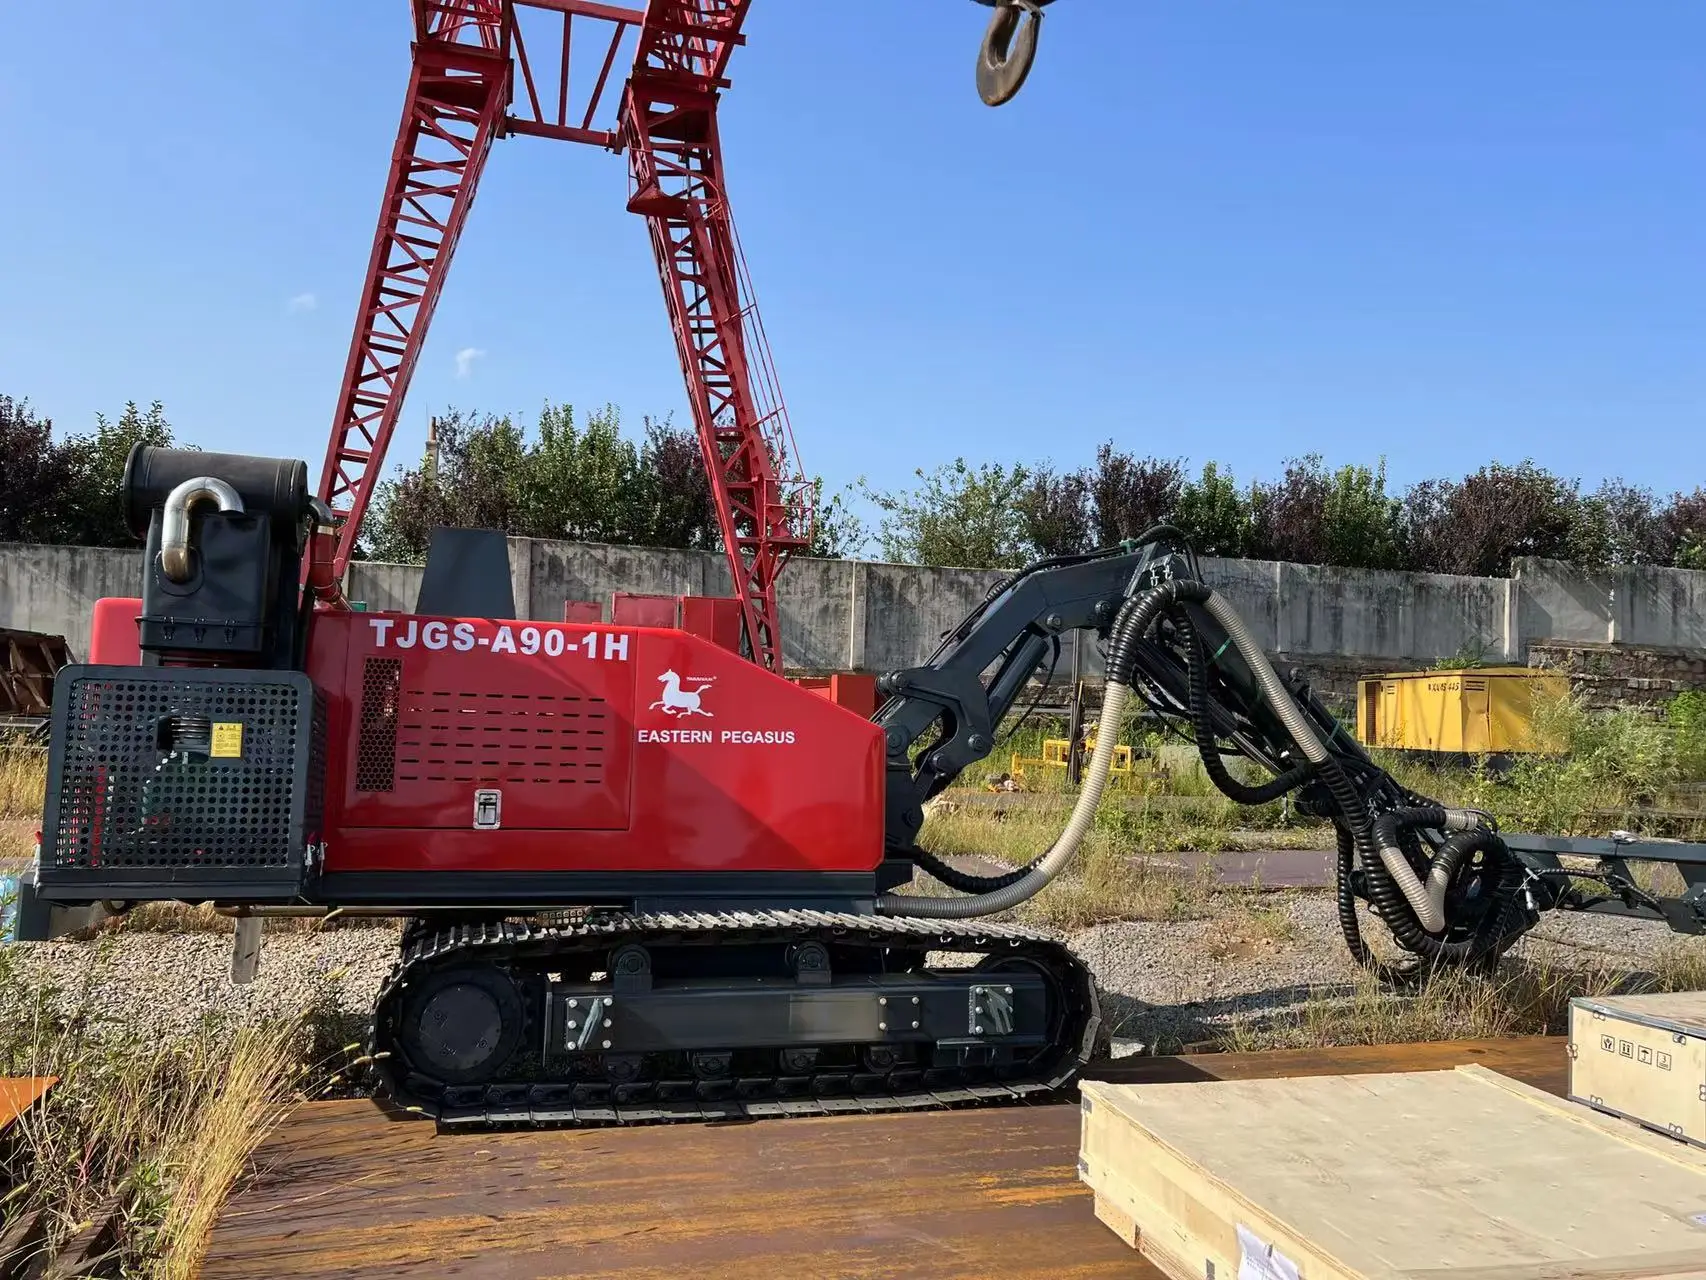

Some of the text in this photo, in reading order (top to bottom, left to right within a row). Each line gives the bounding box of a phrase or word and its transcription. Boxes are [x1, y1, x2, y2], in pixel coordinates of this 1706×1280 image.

[369, 619, 629, 661] TJGS-A90-1H
[638, 730, 796, 744] EASTERN PEGASUS
